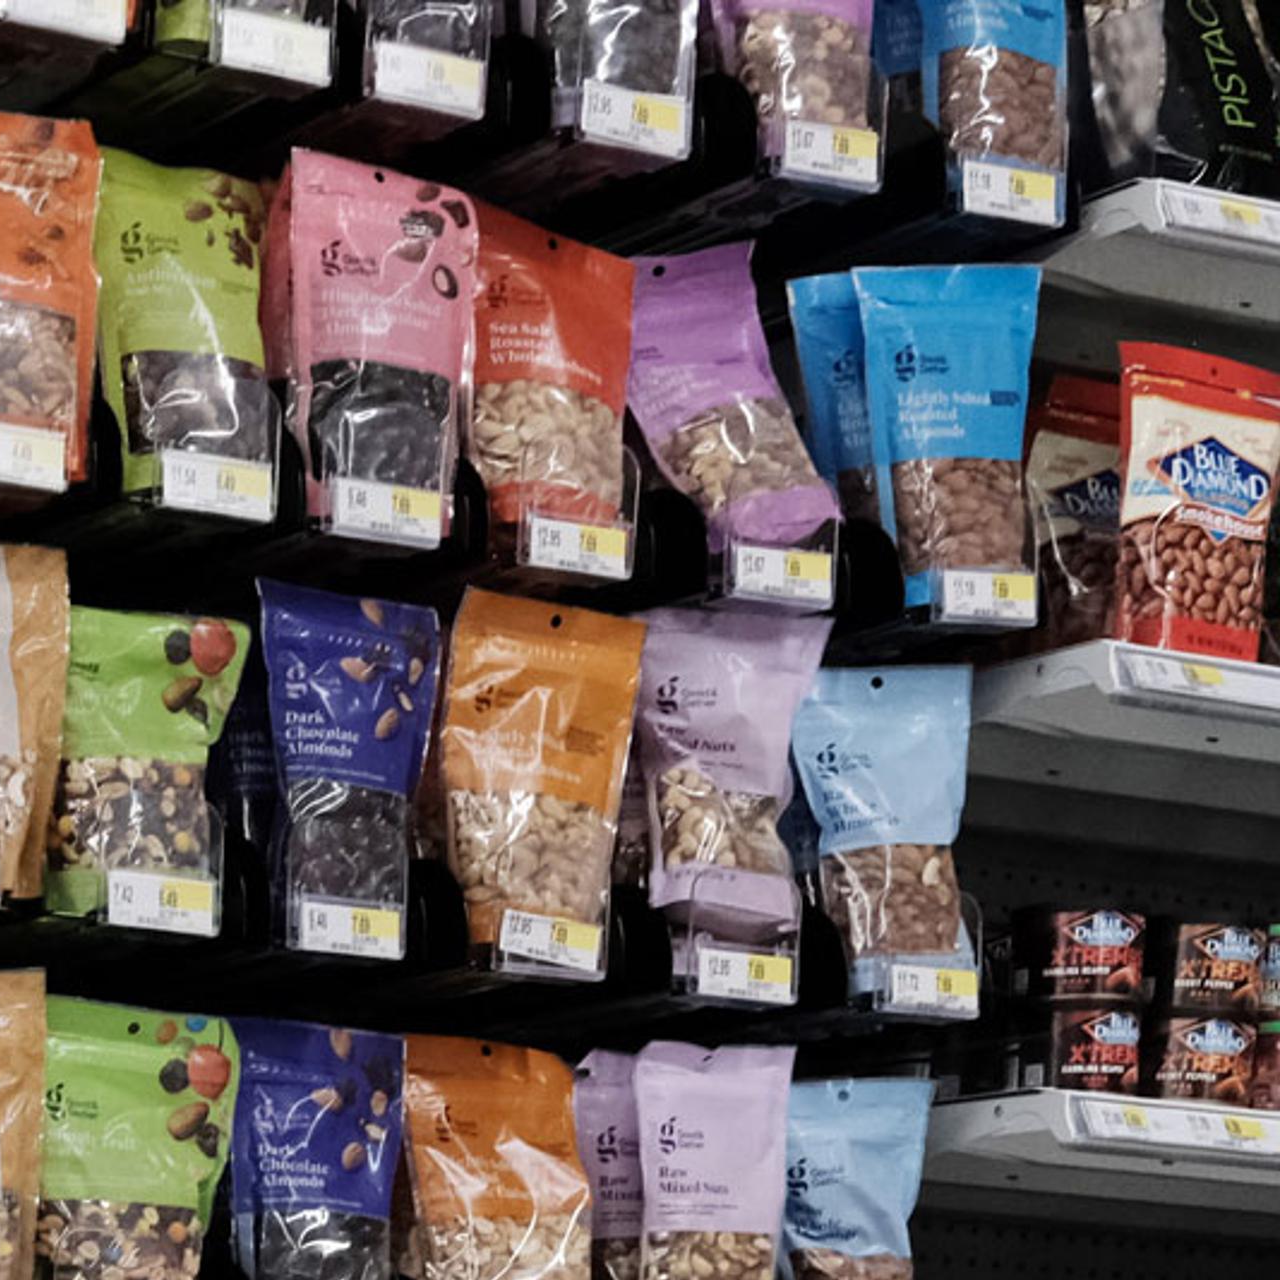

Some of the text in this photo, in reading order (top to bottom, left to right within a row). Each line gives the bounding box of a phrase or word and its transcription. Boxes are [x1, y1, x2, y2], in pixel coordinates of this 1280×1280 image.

[1193, 443, 1242, 478] BLUE
[1173, 458, 1270, 503] DIAMOND
[1176, 504, 1266, 539] Smokehouse
[285, 709, 325, 727] Dark
[284, 725, 360, 745] Chocolate
[285, 739, 353, 758] Almonds
[659, 1166, 688, 1182] Raw
[659, 1179, 731, 1196] Mixed Nuts
